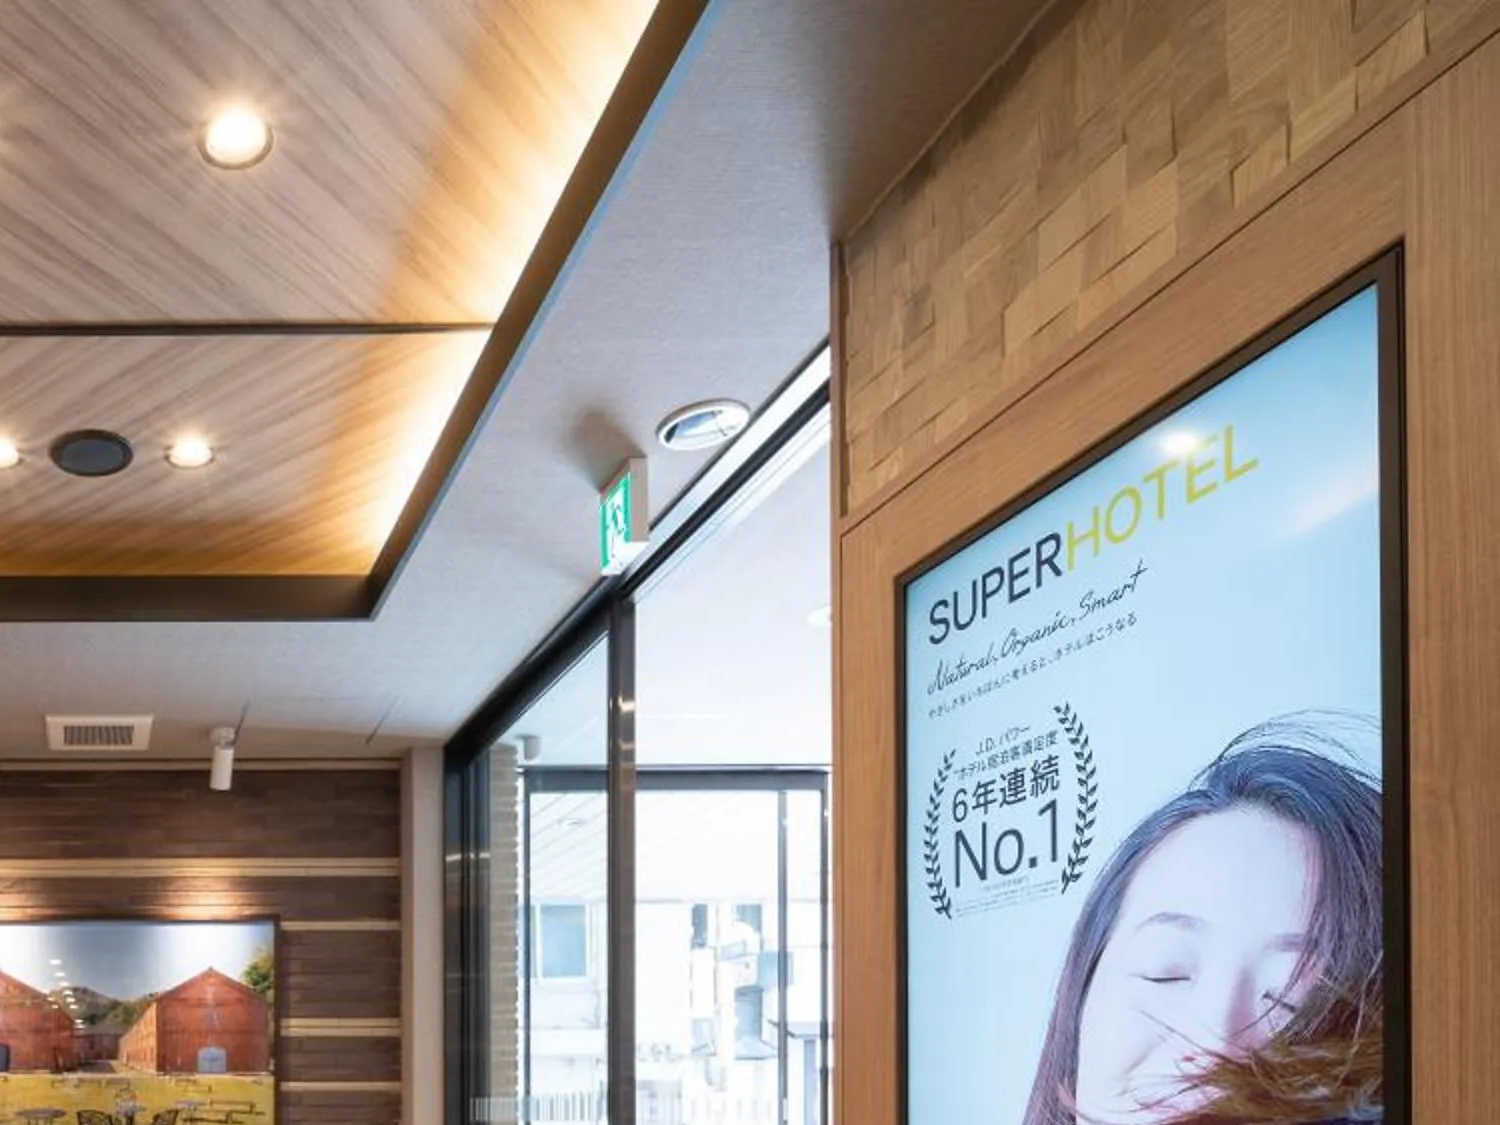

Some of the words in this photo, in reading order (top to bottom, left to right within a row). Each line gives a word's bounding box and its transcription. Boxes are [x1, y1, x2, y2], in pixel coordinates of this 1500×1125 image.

[1079, 558, 1149, 621] Smart
[952, 754, 1061, 824] 6年連続
[955, 798, 1058, 889] No.1
